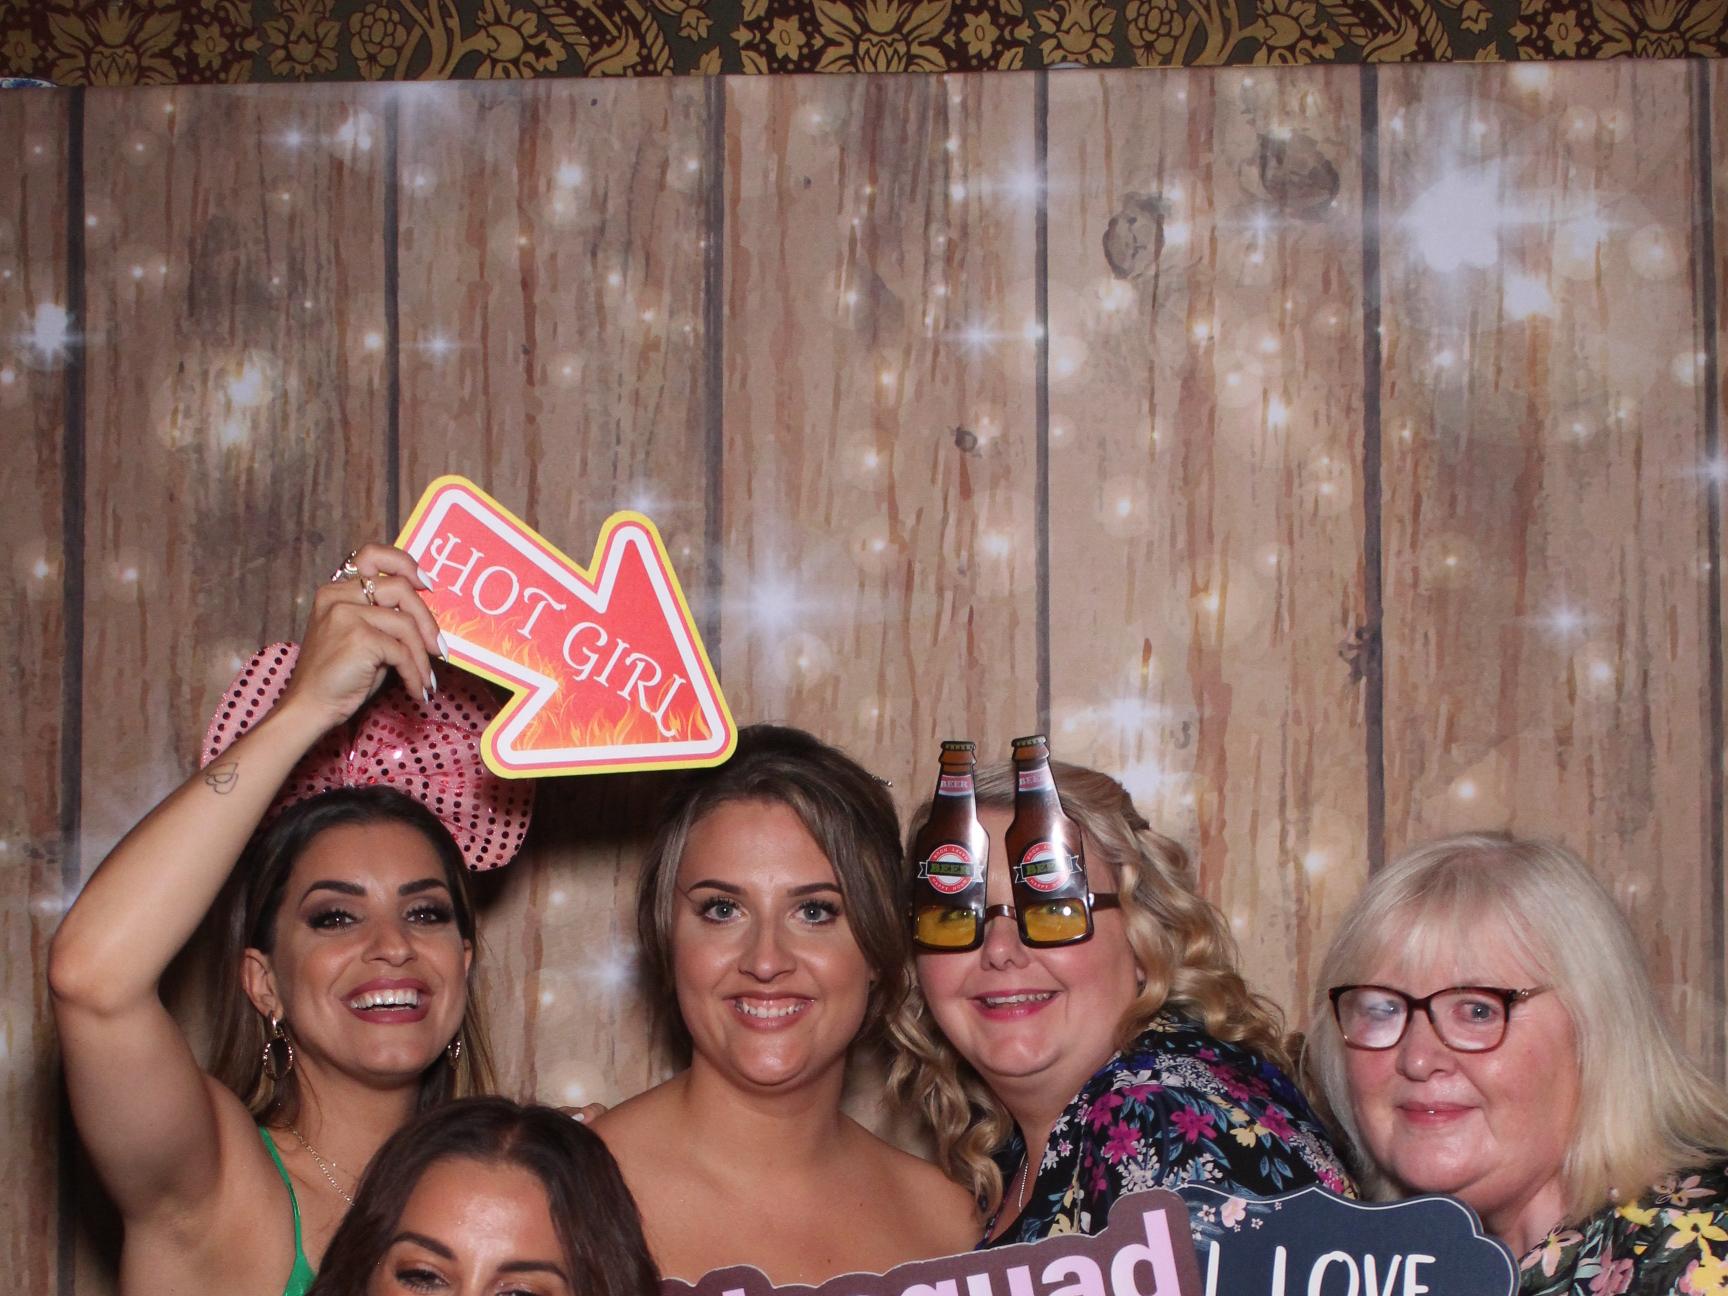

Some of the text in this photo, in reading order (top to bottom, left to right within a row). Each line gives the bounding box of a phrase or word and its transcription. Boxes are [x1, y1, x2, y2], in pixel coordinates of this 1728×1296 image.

[427, 533, 687, 738] HOT GIRL
[940, 779, 968, 789] BEER
